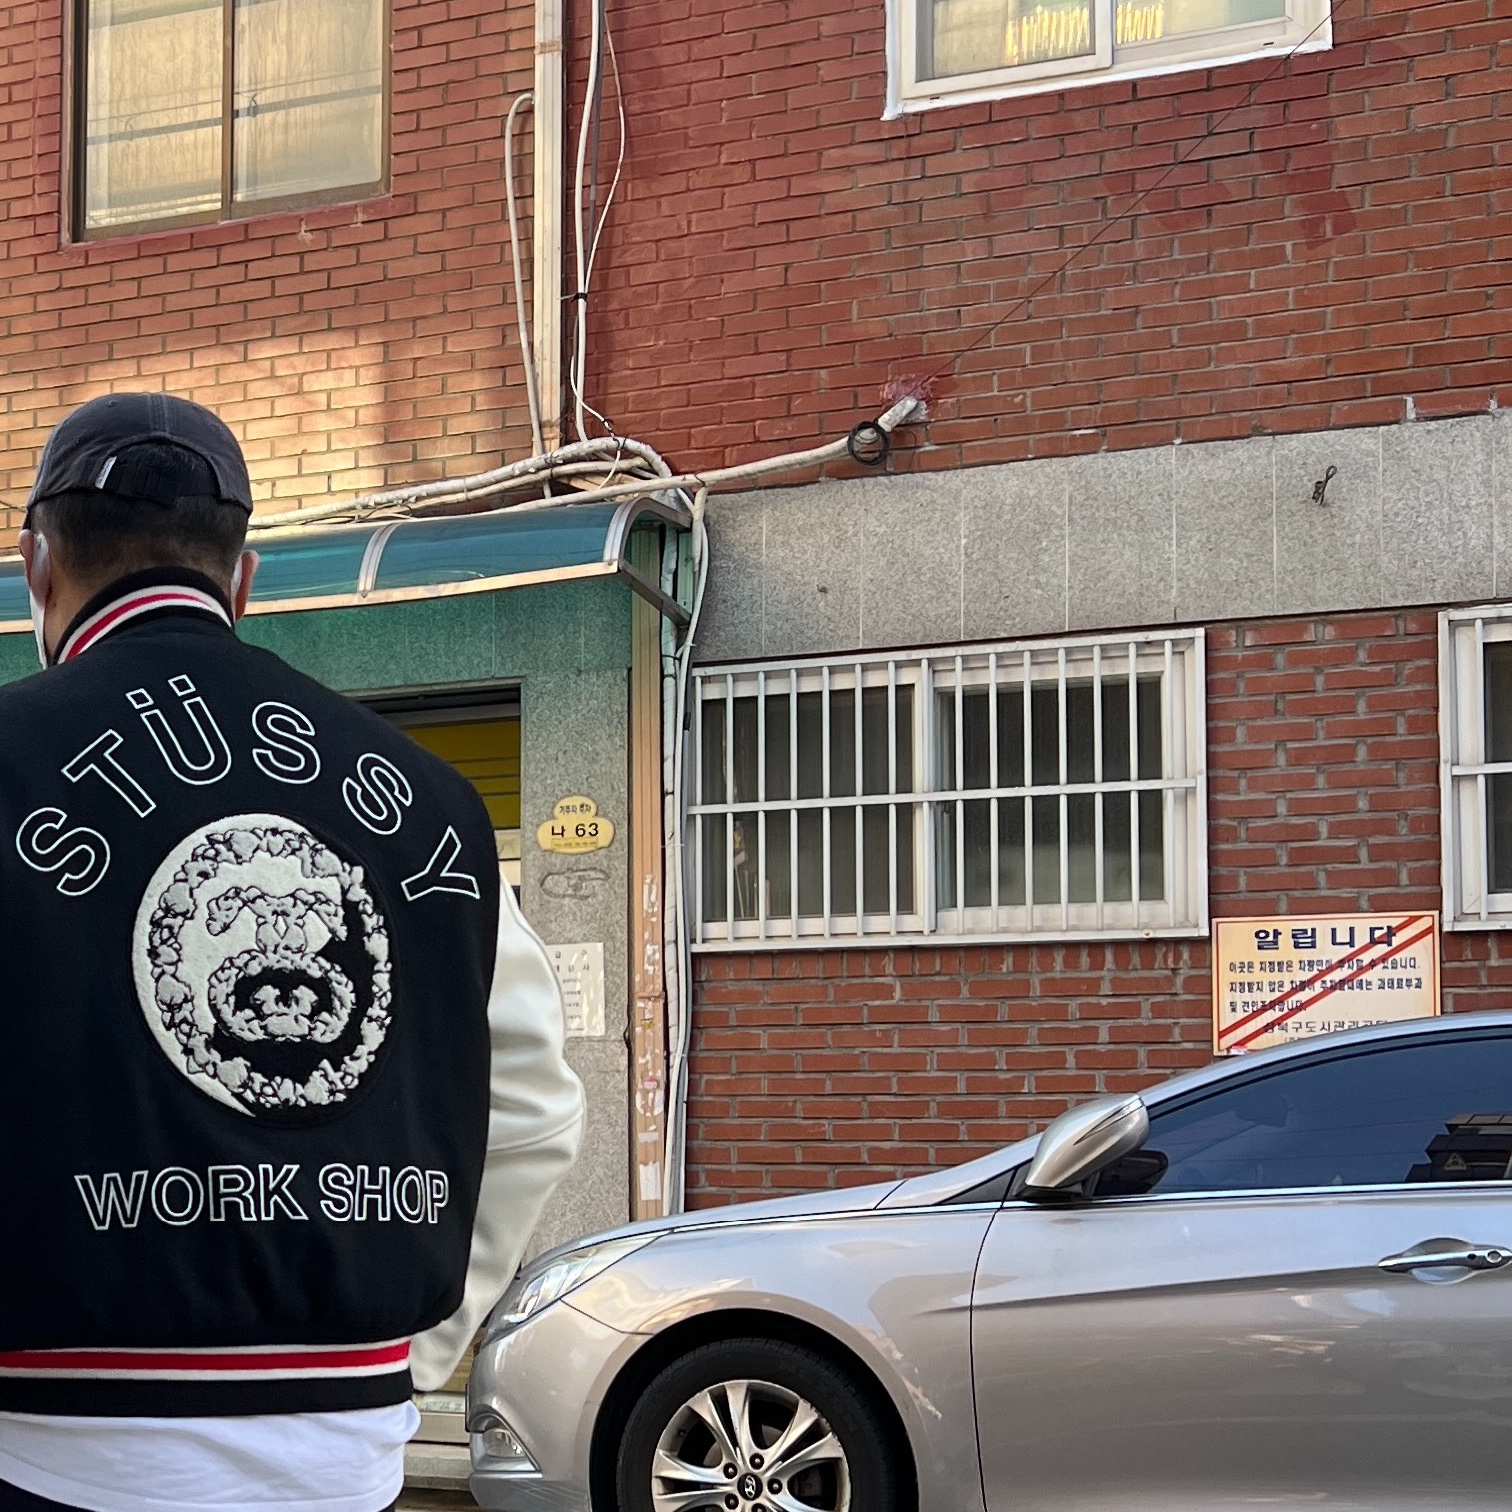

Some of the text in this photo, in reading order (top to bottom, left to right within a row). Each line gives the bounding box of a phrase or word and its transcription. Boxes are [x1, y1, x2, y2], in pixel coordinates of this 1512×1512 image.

[16, 674, 481, 902] STÜSSY
[551, 822, 599, 838] 나 63
[1254, 925, 1396, 951] 알립니다
[74, 1163, 449, 1231] WORK SHOP
